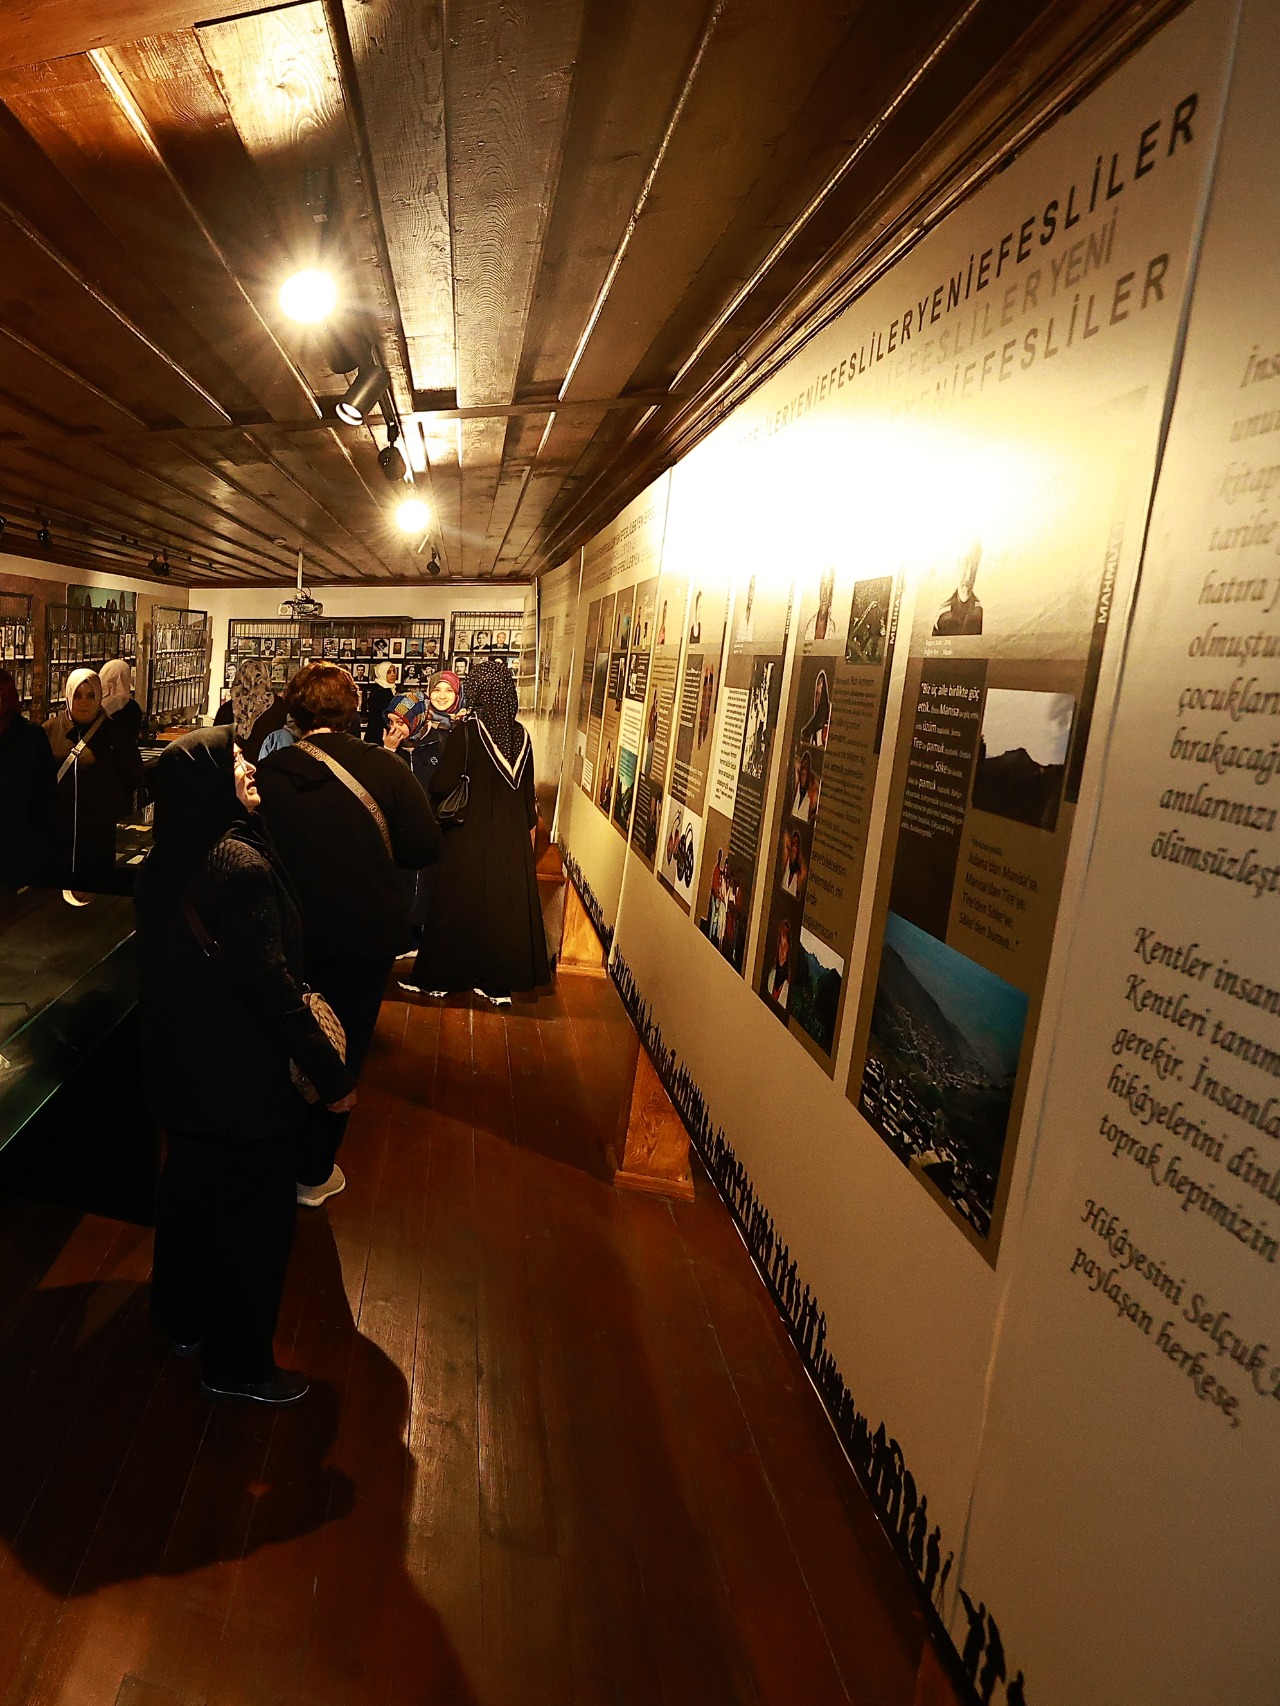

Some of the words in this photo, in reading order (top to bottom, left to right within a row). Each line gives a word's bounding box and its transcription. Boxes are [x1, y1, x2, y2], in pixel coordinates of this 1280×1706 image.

[1159, 782, 1278, 832] anılarınızı
[1133, 926, 1213, 981] Kentler
[1125, 973, 1212, 1037] Kentleri
[1110, 1028, 1185, 1081] gerekir.
[1107, 1062, 1229, 1164] hikâyelerini
[1098, 1113, 1163, 1187] toprak
[1162, 1156, 1279, 1263] hepimizin
[1070, 1246, 1154, 1336] paylaşan
[1156, 1320, 1242, 1429] herkese,
[1080, 1198, 1186, 1306] Hikâyesini
[1182, 1293, 1270, 1396] Selçuk
